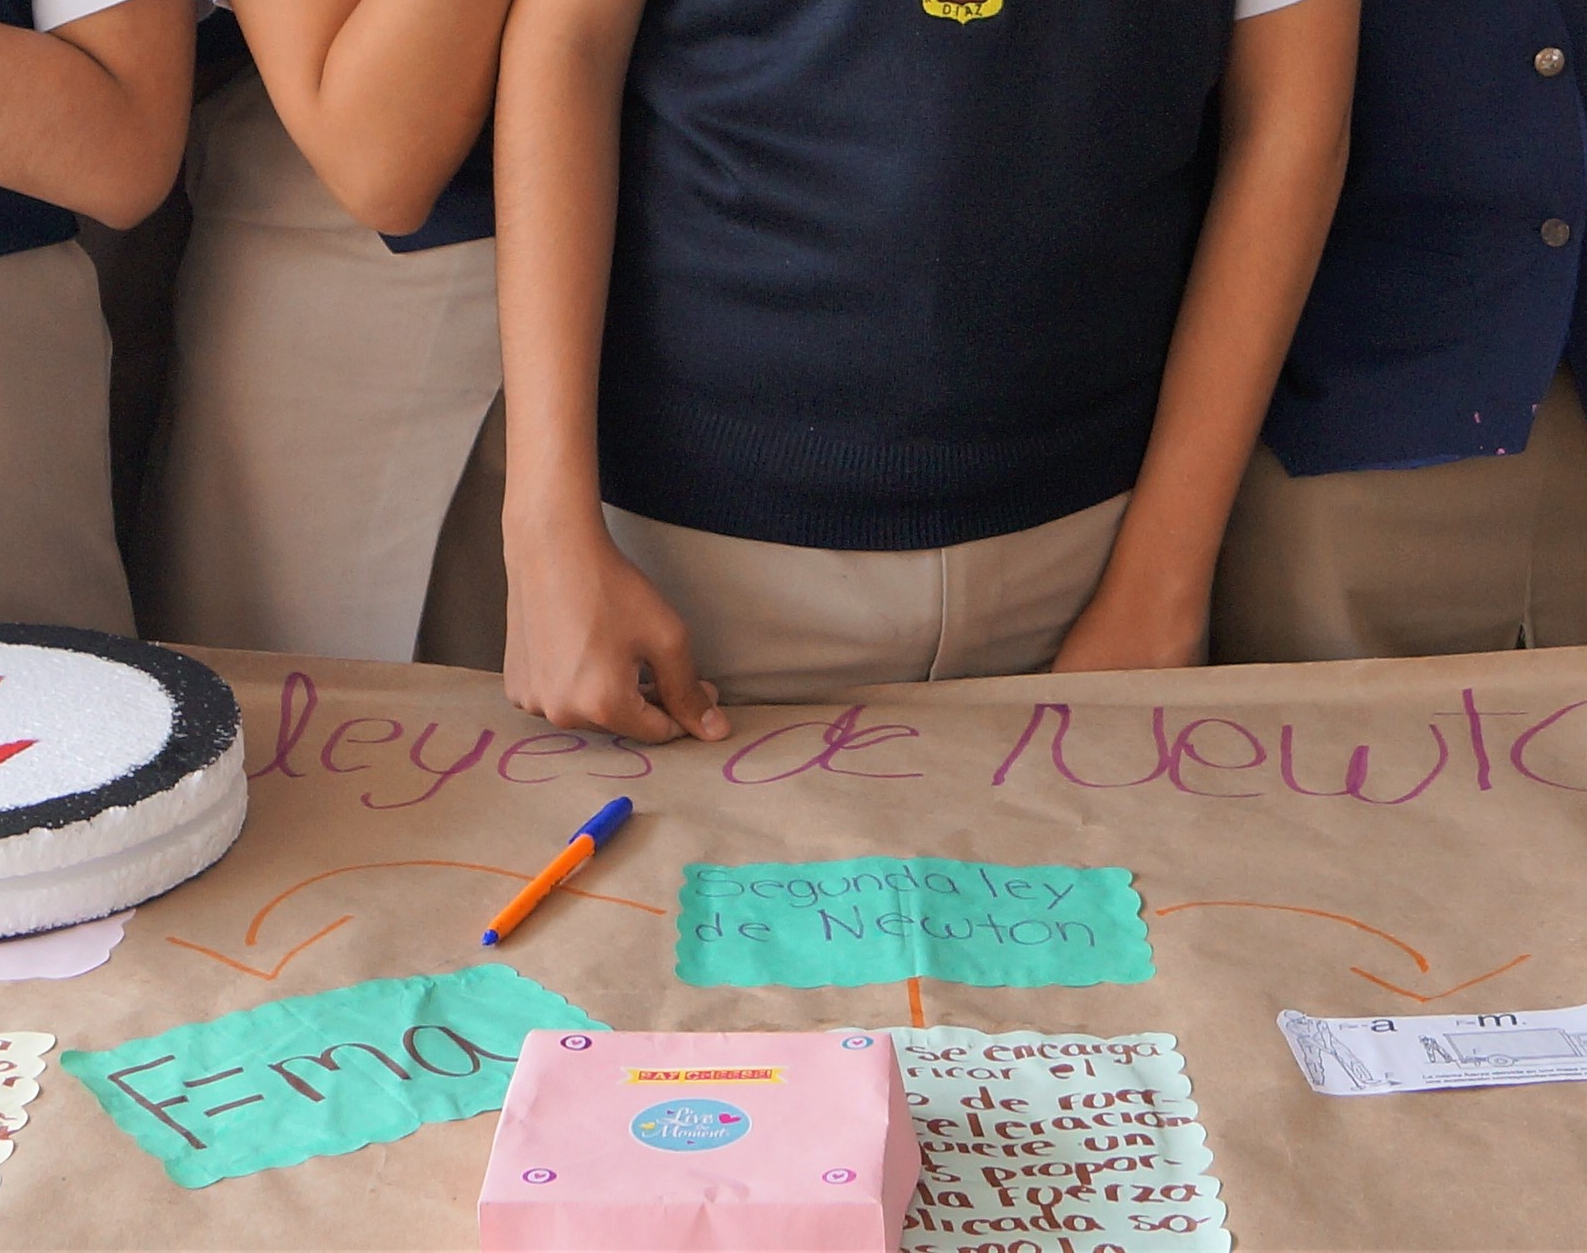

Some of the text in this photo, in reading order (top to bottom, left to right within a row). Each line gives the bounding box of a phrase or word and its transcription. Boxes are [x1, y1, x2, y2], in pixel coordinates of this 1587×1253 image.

[942, 4, 983, 17] DIAZ
[721, 703, 925, 786] de
[693, 864, 1076, 910] Segunda ley
[694, 904, 1096, 947] de Newton
[638, 1071, 681, 1081] SAY
[1048, 1058, 1097, 1080] el
[960, 1086, 1030, 1114] de
[656, 1107, 714, 1127] Live
